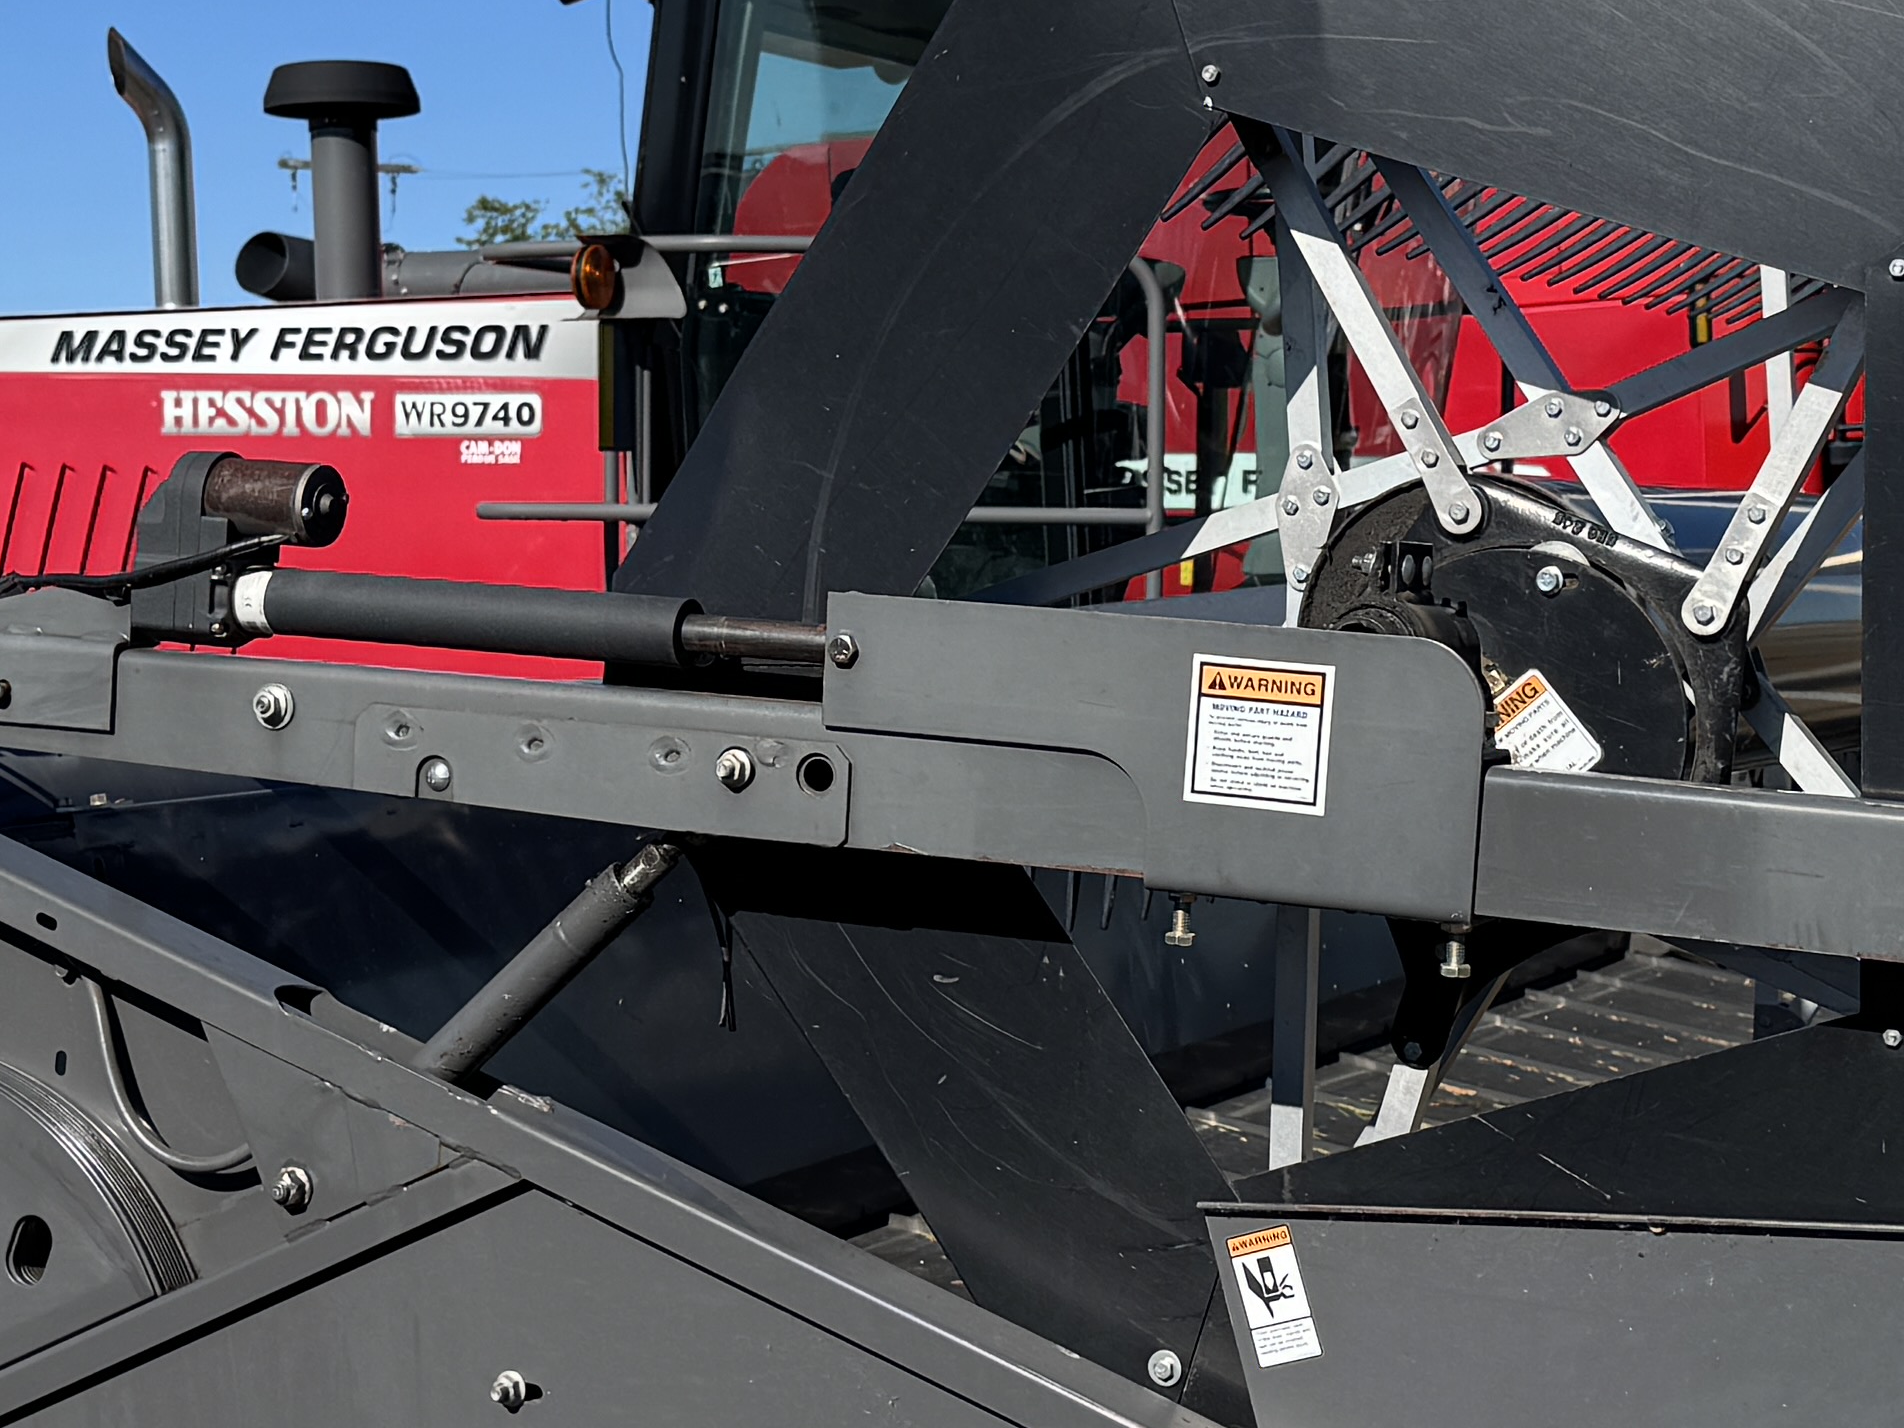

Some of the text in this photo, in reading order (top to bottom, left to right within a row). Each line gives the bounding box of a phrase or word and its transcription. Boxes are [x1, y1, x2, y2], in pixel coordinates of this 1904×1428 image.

[51, 323, 549, 365] MASSEY FERGUSON
[160, 391, 536, 437] HESSTON WR9740
[1228, 674, 1316, 697] WARNING
[1239, 1230, 1288, 1250] WARNING
